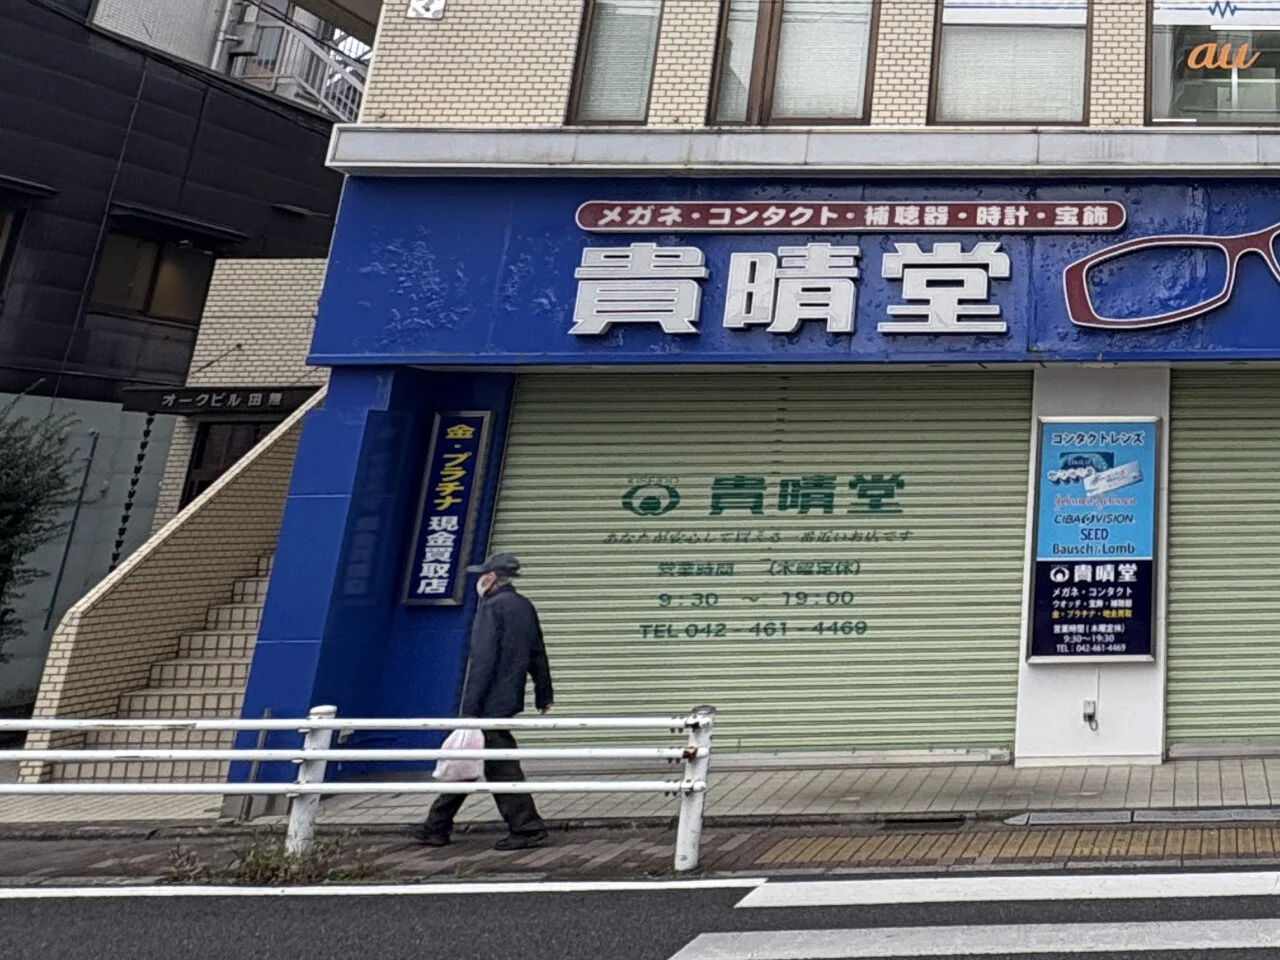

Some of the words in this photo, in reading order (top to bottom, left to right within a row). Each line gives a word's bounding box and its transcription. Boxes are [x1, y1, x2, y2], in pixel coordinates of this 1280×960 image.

[1187, 43, 1262, 70] au
[567, 242, 1011, 335] 貴晴堂
[1051, 430, 1146, 446] コンタクトレンズ
[708, 473, 905, 516] 貴晴堂
[1095, 513, 1134, 524] VISION
[1080, 528, 1109, 541] SEED
[416, 515, 459, 594] 現金買取店
[1052, 543, 1093, 554] Bausch
[1102, 542, 1135, 554] Lomb
[1073, 563, 1138, 582] 貴晴堂
[638, 624, 680, 639] TEL
